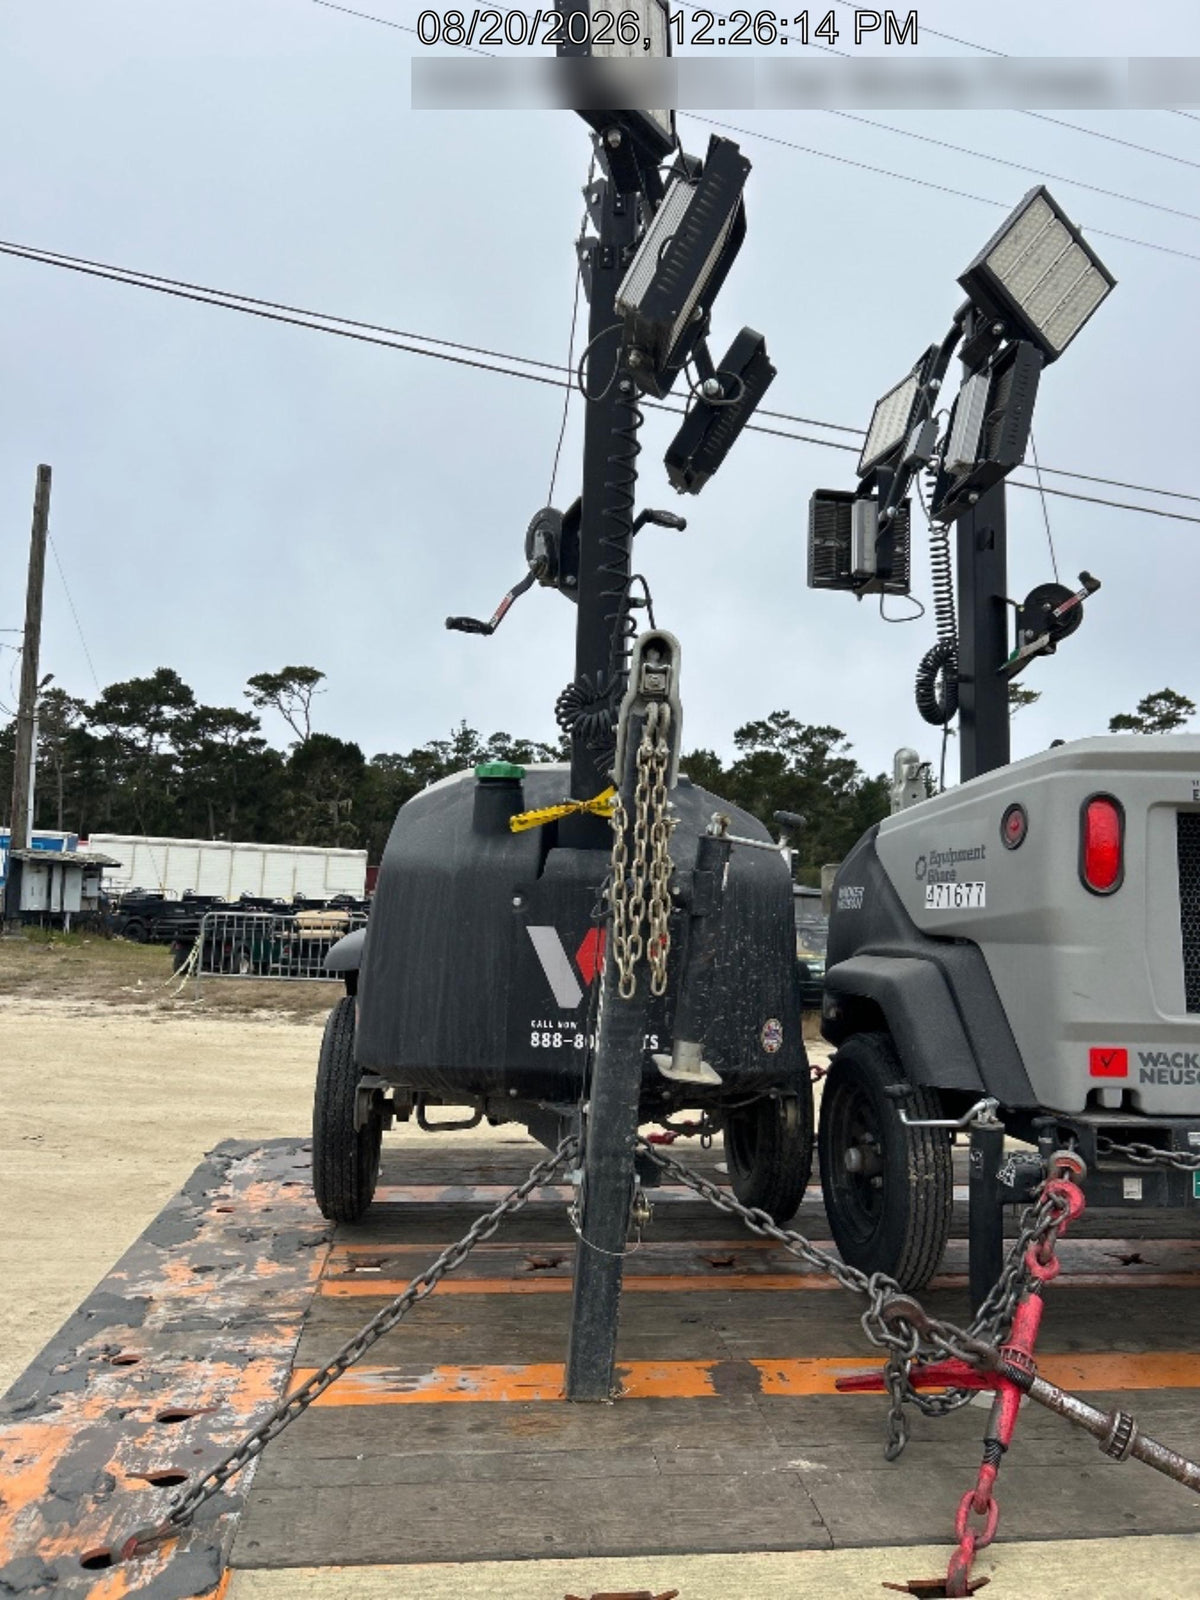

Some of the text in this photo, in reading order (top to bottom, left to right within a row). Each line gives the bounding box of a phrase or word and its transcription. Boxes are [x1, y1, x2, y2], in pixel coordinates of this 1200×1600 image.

[929, 844, 986, 868] Equipment
[927, 883, 984, 907] 471677
[531, 1020, 554, 1029] CALL
[1139, 1068, 1200, 1086] NEUS
